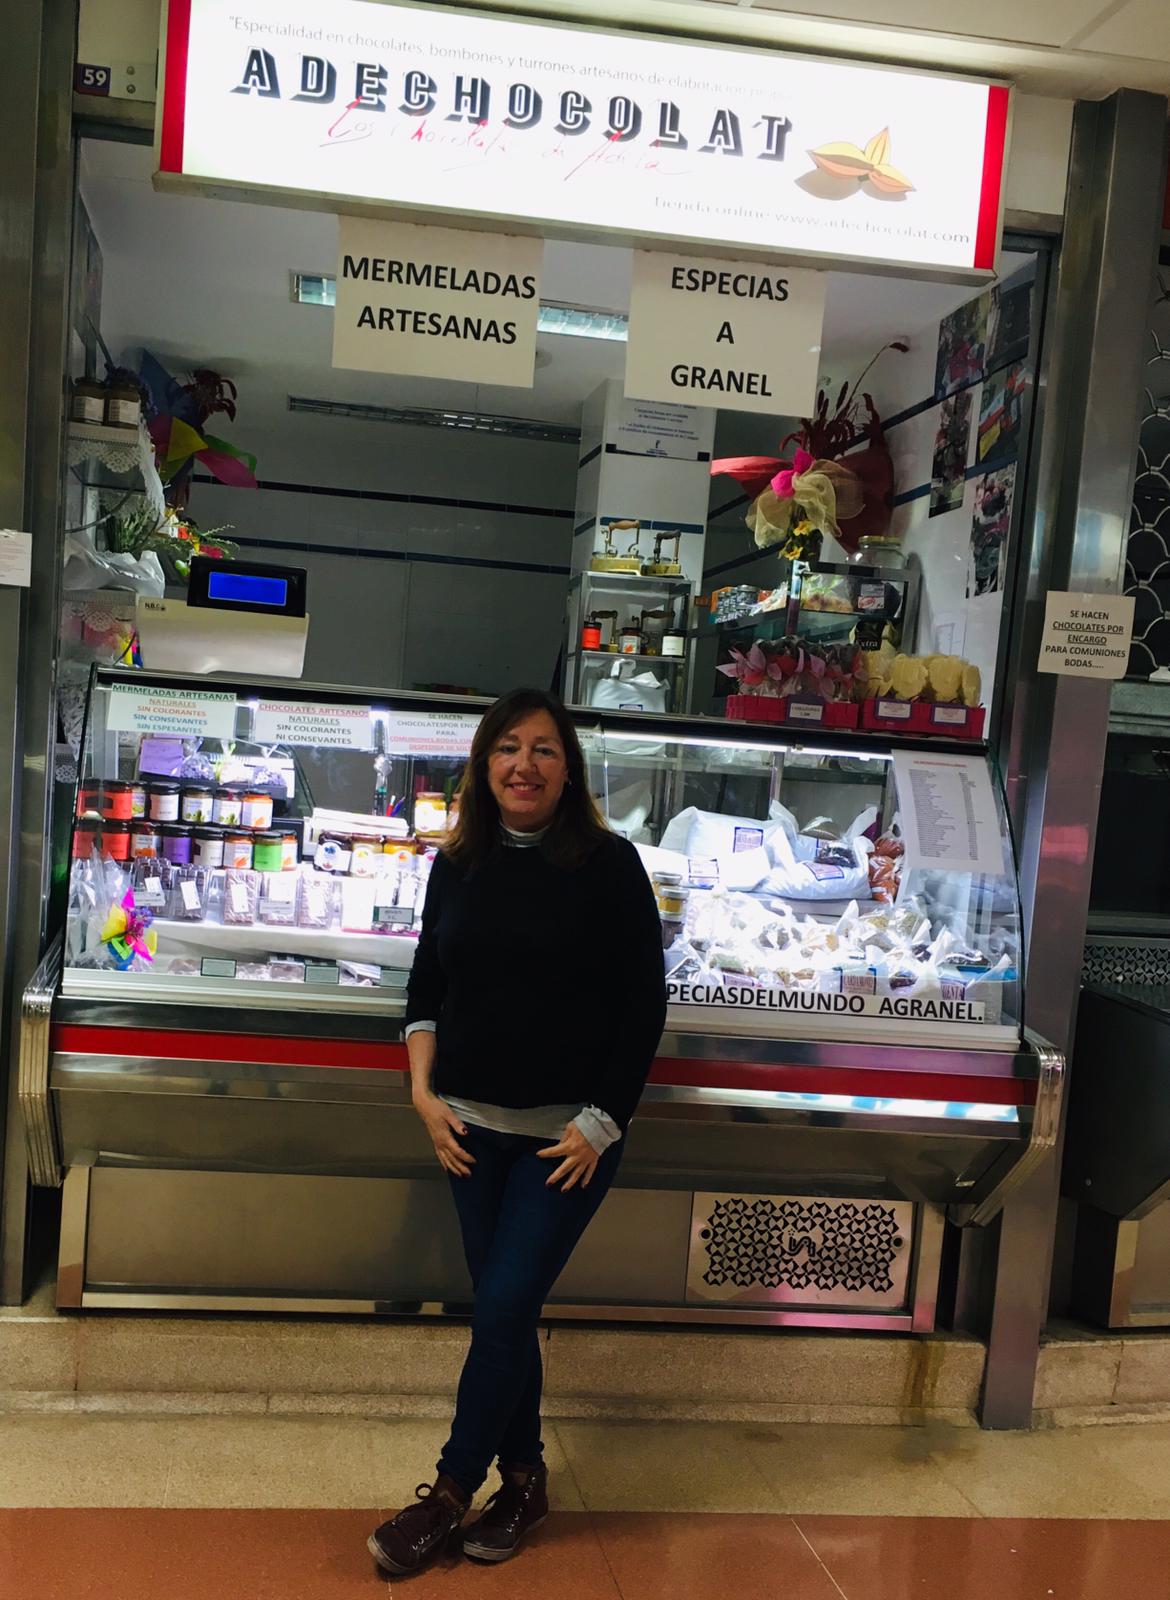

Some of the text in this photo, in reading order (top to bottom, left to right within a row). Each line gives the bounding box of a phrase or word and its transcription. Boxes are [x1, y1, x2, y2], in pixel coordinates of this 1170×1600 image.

[326, 30, 344, 43] en
[430, 44, 503, 64] bombones
[507, 56, 516, 69] y
[519, 56, 576, 75] turrones
[579, 64, 642, 82] artesanos
[648, 70, 665, 84] de
[83, 68, 107, 86] 59
[228, 46, 794, 163] ADECHOCOLAT
[714, 202, 771, 220] online
[775, 213, 970, 244] www.adechocolat.com
[343, 255, 536, 299] MERMELADAS
[672, 267, 789, 301] ESPECIAS
[357, 306, 517, 344] ARTESANAS
[716, 321, 735, 344] A
[671, 364, 772, 397] GRANEL
[1070, 610, 1109, 620] SE HACEN
[1052, 621, 1124, 634] CHOCOLATES POR
[1067, 635, 1107, 645] ENCARGO
[1045, 645, 1126, 658] PARA COMUNIONES
[112, 684, 235, 701] MERMELADAS ARTESANAS
[149, 698, 197, 708] NATURALES
[259, 703, 316, 714] CHOCOLATES
[137, 705, 207, 718] SIN COLORANTES
[133, 713, 208, 726] SIN CONSEVANTES
[288, 715, 341, 726] NATURALES
[137, 722, 203, 735] SIN ESPESANTES
[292, 725, 352, 735] COLORANTES
[276, 733, 352, 745] NI CONSEVANTES
[666, 983, 983, 1021] PECIASDELMUNDO AGRANEL.
